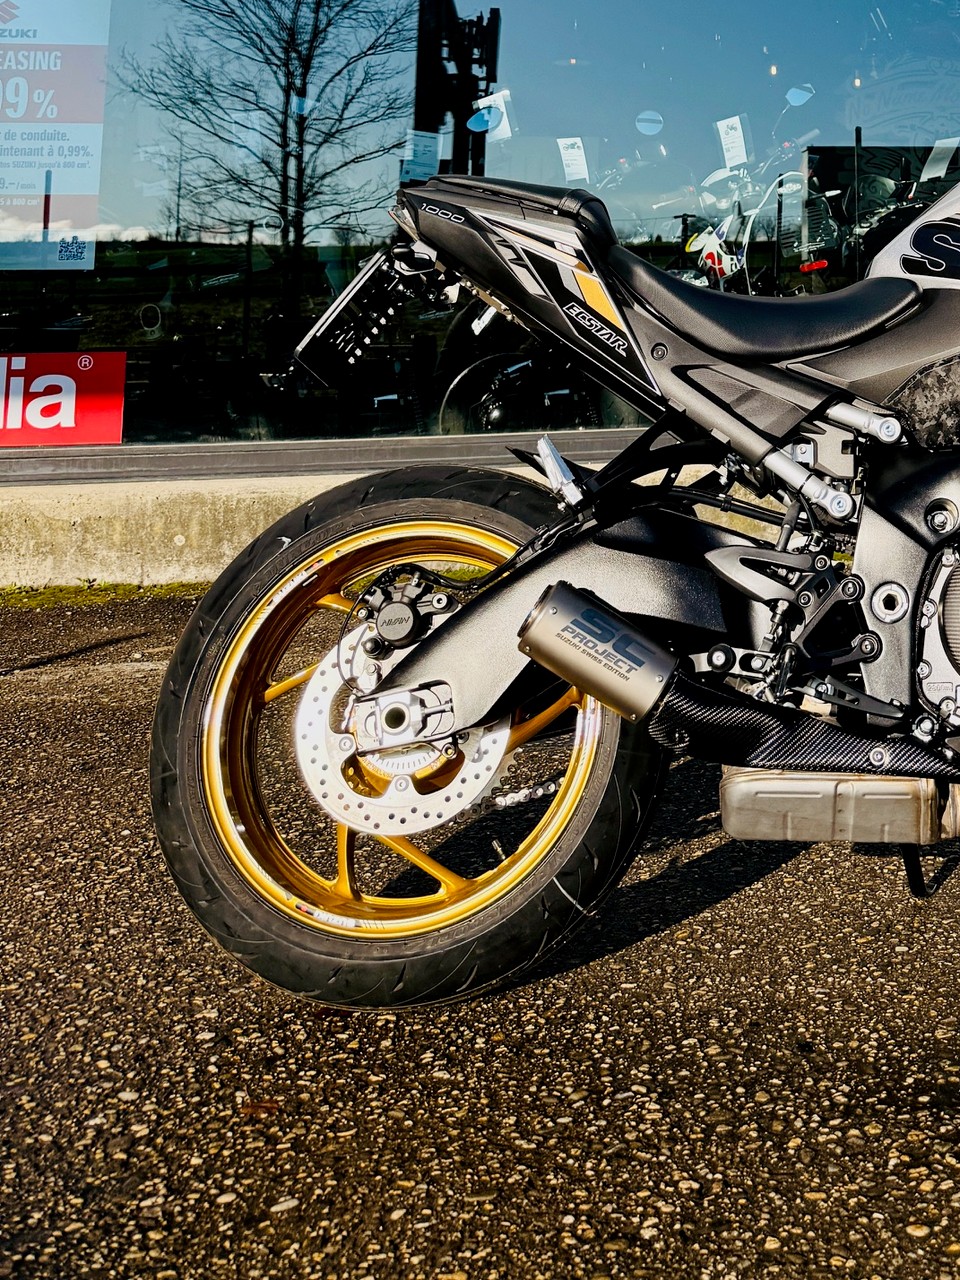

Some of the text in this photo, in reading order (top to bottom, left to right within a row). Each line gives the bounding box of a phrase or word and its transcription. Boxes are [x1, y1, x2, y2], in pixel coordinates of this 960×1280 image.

[4, 129, 69, 141] de conduite.
[47, 145, 54, 157] à
[58, 145, 94, 159] 0,99%.
[12, 160, 36, 169] SUZUKI
[421, 203, 465, 223] 1000
[563, 302, 628, 358] ECSTAR
[560, 625, 638, 674] PROJECT
[569, 607, 657, 668] SC
[555, 632, 631, 682] SUZUKI SWISS EDITION
